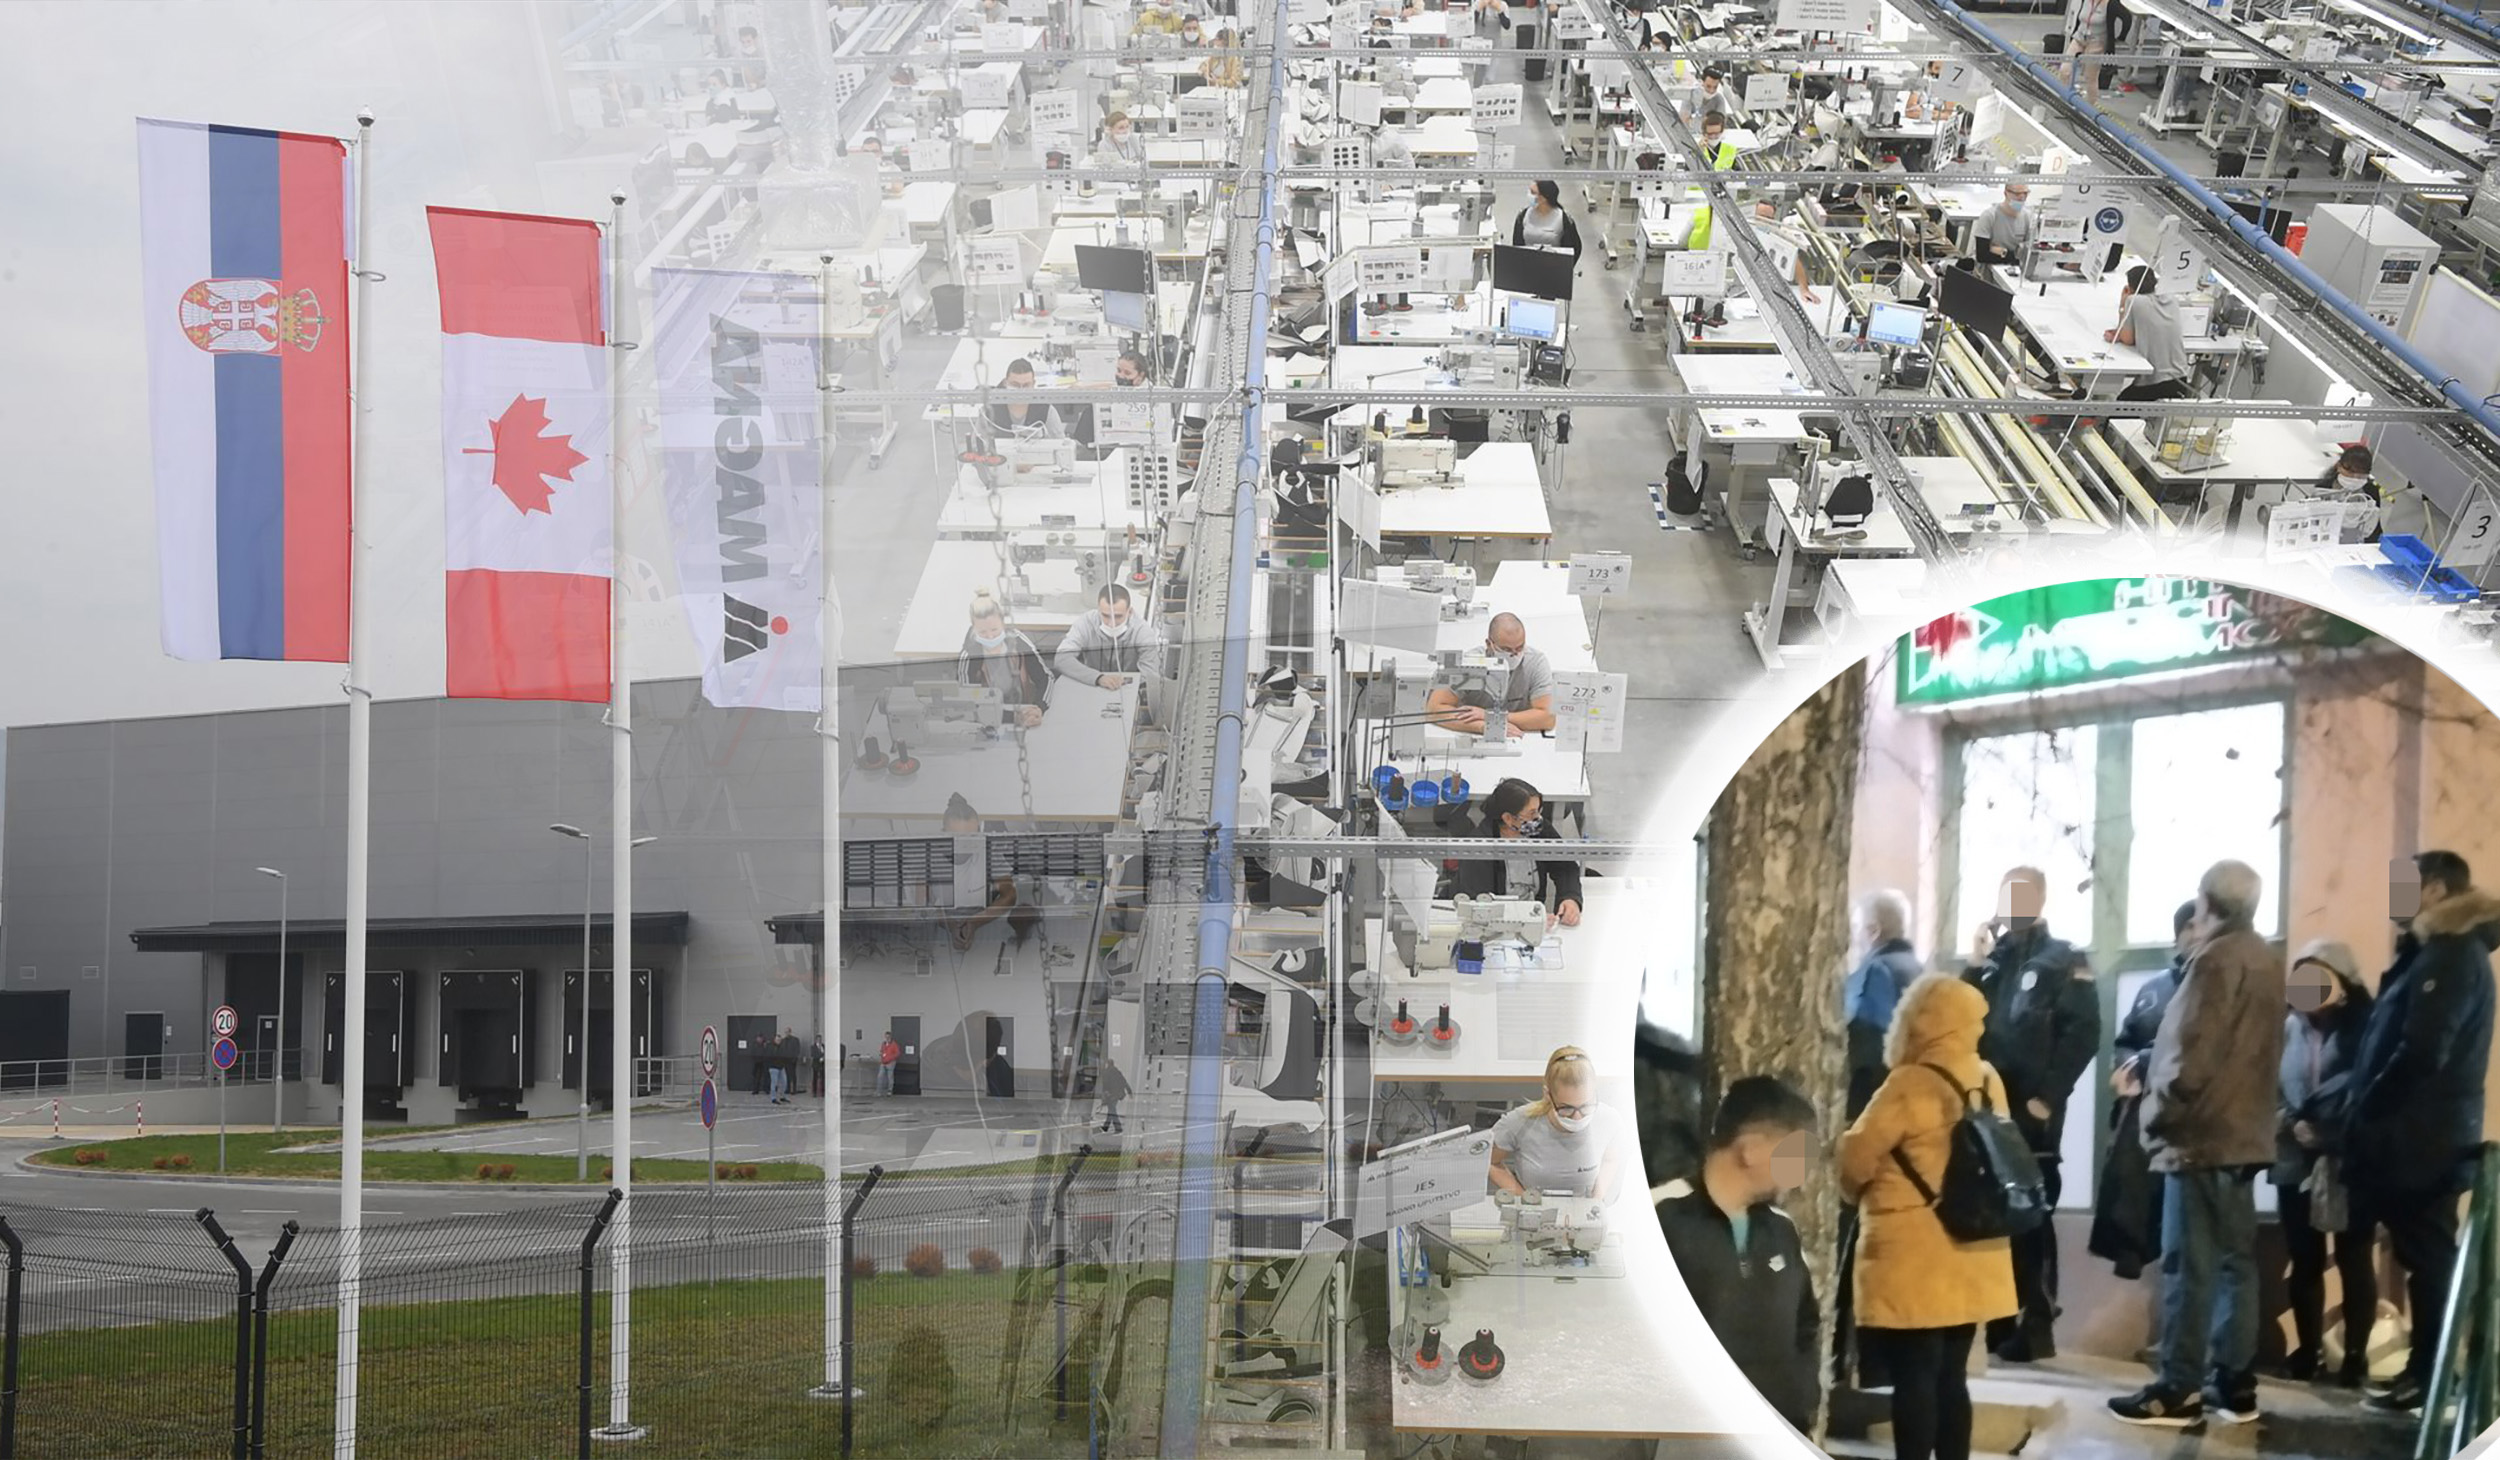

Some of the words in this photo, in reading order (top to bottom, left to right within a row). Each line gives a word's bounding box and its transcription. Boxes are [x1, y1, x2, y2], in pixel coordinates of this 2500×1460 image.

[1952, 66, 1965, 82] 7
[2177, 250, 2191, 270] 5
[2472, 515, 2492, 538] 3
[1589, 569, 1609, 578] 173
[1573, 686, 1597, 699] 272
[218, 1014, 233, 1030] 20
[705, 1039, 714, 1065] 20
[1414, 1179, 1435, 1193] JES
